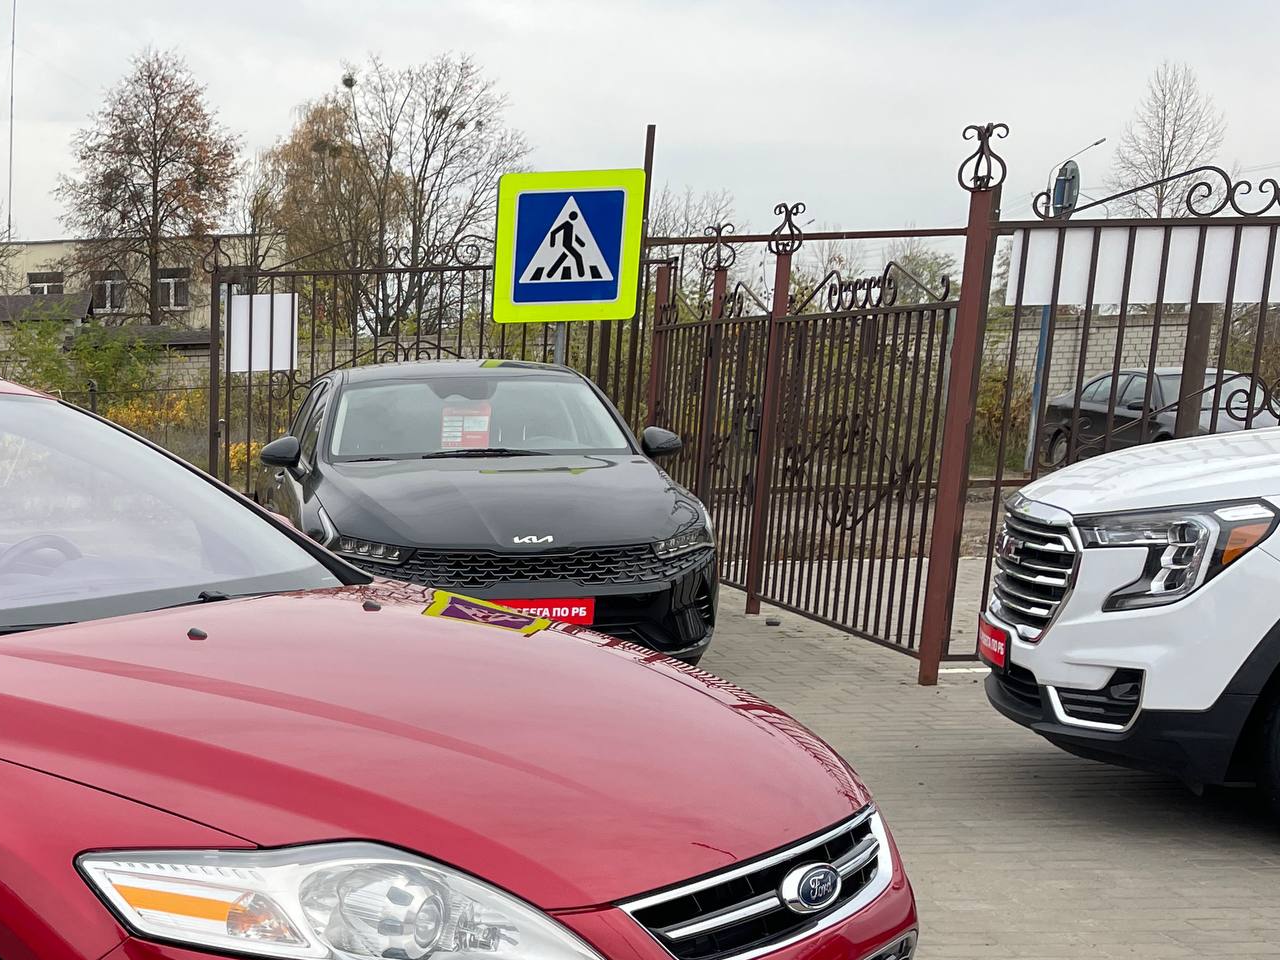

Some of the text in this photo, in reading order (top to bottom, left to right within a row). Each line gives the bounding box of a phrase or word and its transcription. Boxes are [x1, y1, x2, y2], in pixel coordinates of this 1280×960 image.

[552, 607, 569, 617] ПО
[571, 606, 587, 617] РБ
[809, 874, 833, 901] Ford
